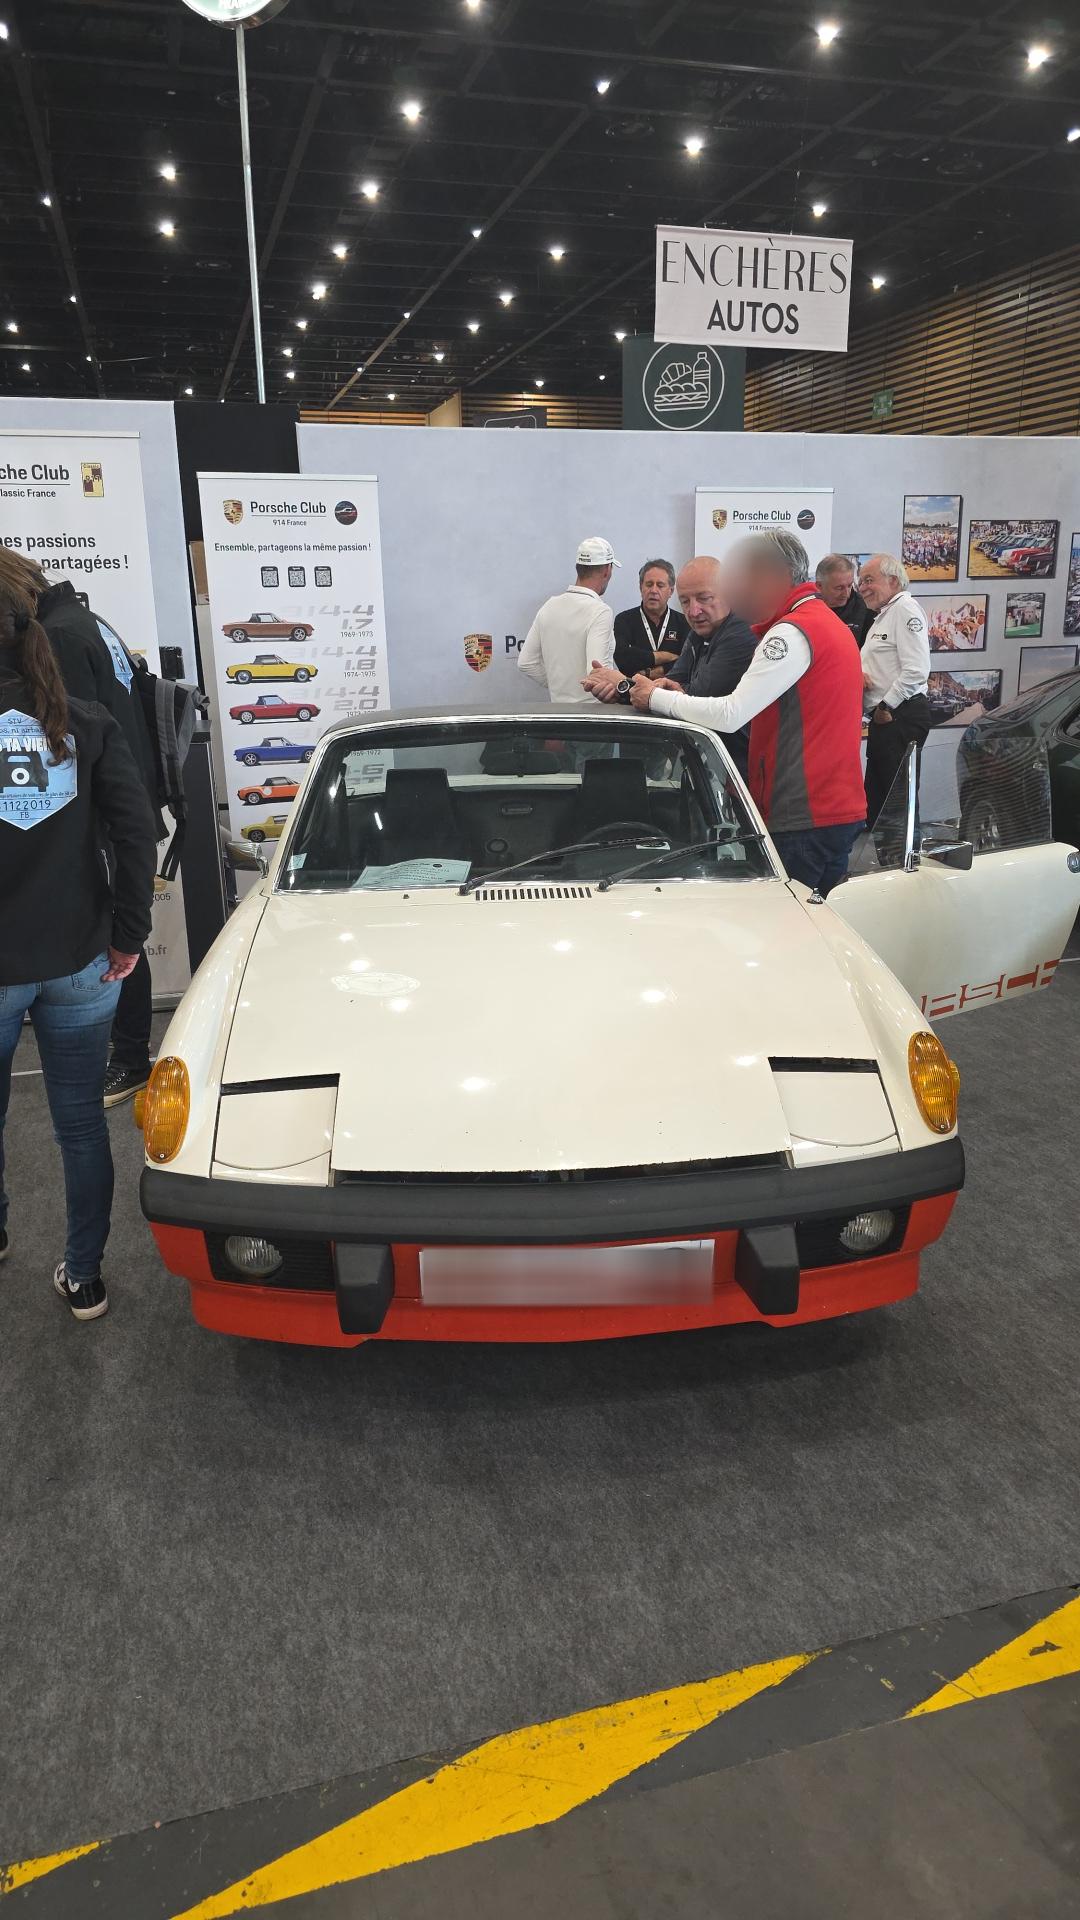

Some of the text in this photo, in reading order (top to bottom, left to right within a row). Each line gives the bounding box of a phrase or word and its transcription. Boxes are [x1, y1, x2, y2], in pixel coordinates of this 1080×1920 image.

[662, 237, 848, 294] ENCHÈRES
[707, 299, 799, 335] AUTOS
[0, 464, 27, 480] che
[31, 464, 70, 480] Club
[0, 489, 56, 498] lassic France
[250, 501, 326, 514] Porsche Club
[733, 510, 791, 521] Porsche Club
[26, 532, 96, 552] passions
[214, 543, 257, 552] Ensemble,
[258, 544, 302, 553] partageons
[304, 543, 311, 551] la
[313, 543, 337, 551] même
[338, 544, 367, 552] passion
[41, 554, 121, 573] partagées
[342, 618, 374, 630] 1.7
[344, 658, 377, 671] 1.8
[334, 698, 378, 711] 2.0
[0, 800, 51, 811] 1122019
